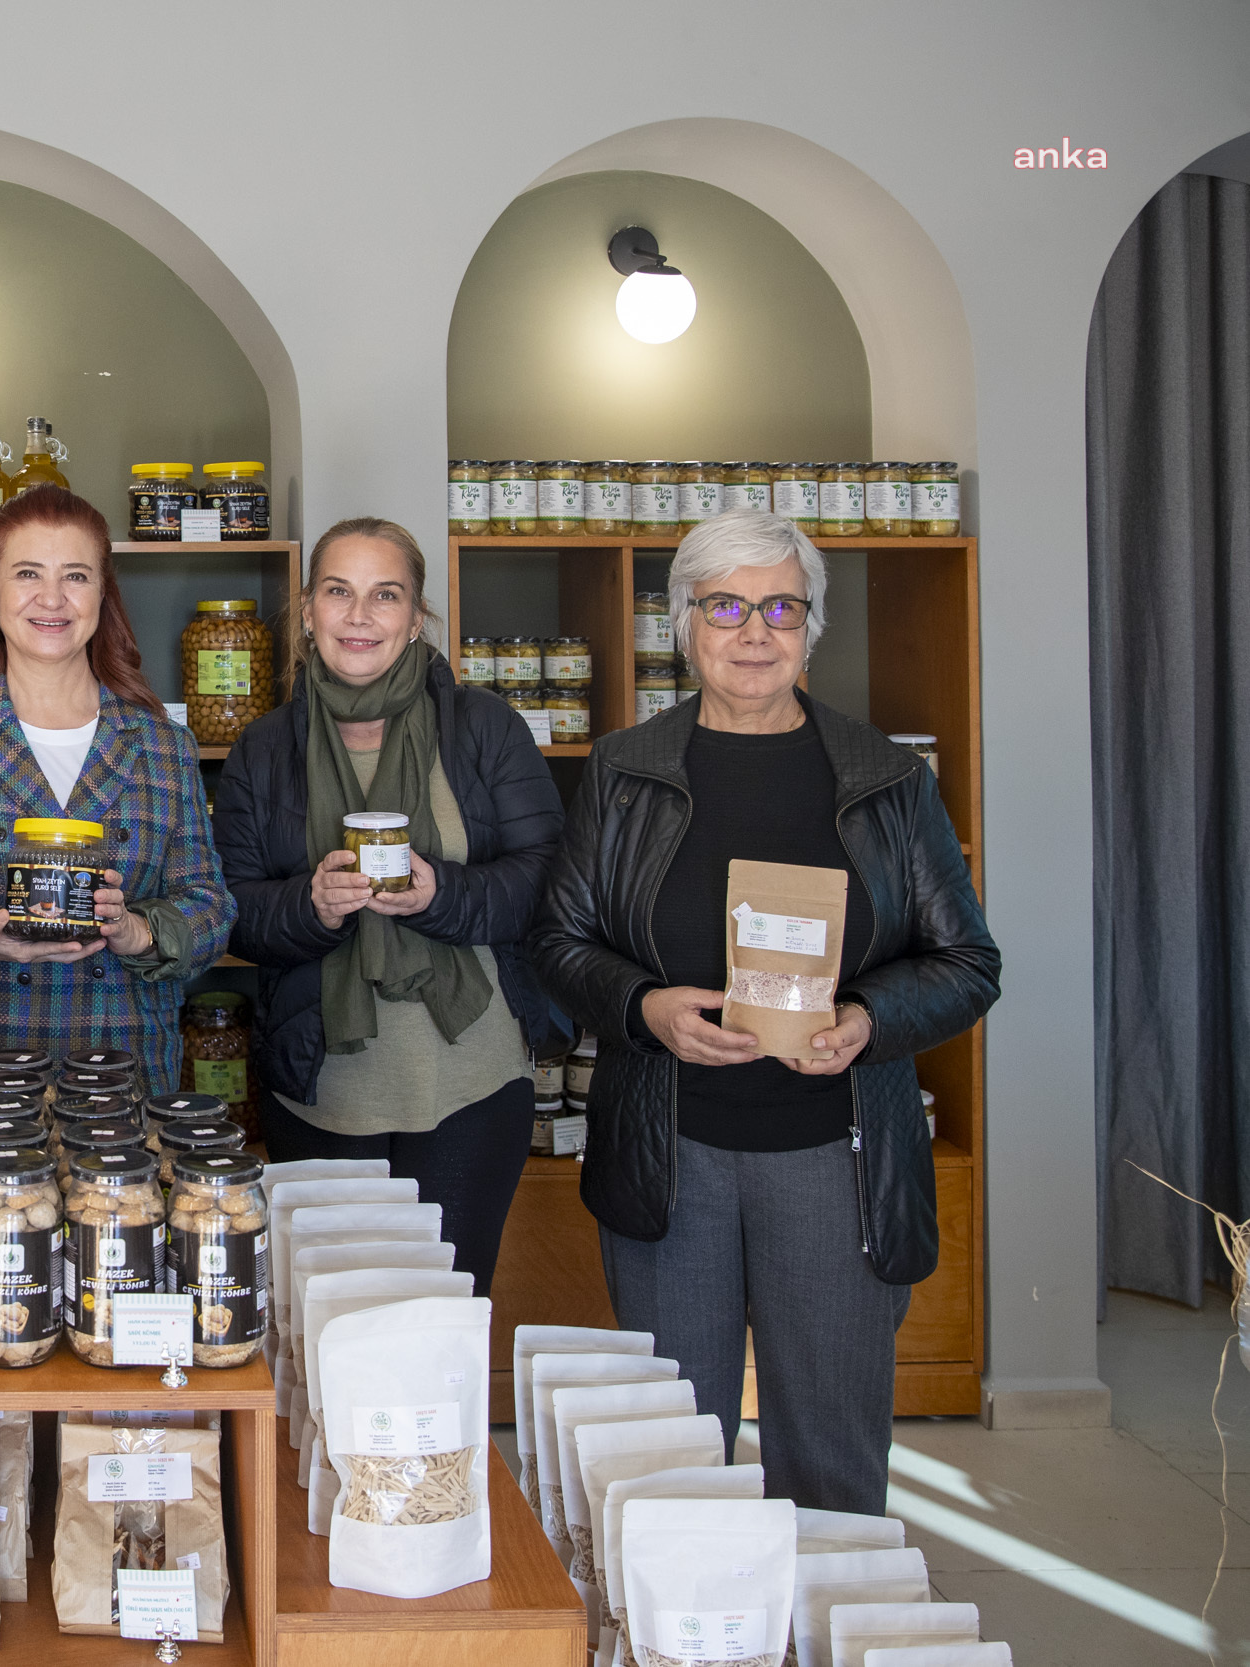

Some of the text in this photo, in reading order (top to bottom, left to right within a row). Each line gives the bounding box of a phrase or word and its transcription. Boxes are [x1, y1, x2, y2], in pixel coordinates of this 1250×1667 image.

[97, 1269, 134, 1278] HAZEK
[119, 1279, 150, 1290] KÖMBE
[198, 1277, 235, 1285] HAZEK
[17, 1284, 47, 1296] KÖMBE
[220, 1287, 251, 1297] KÖMBE
